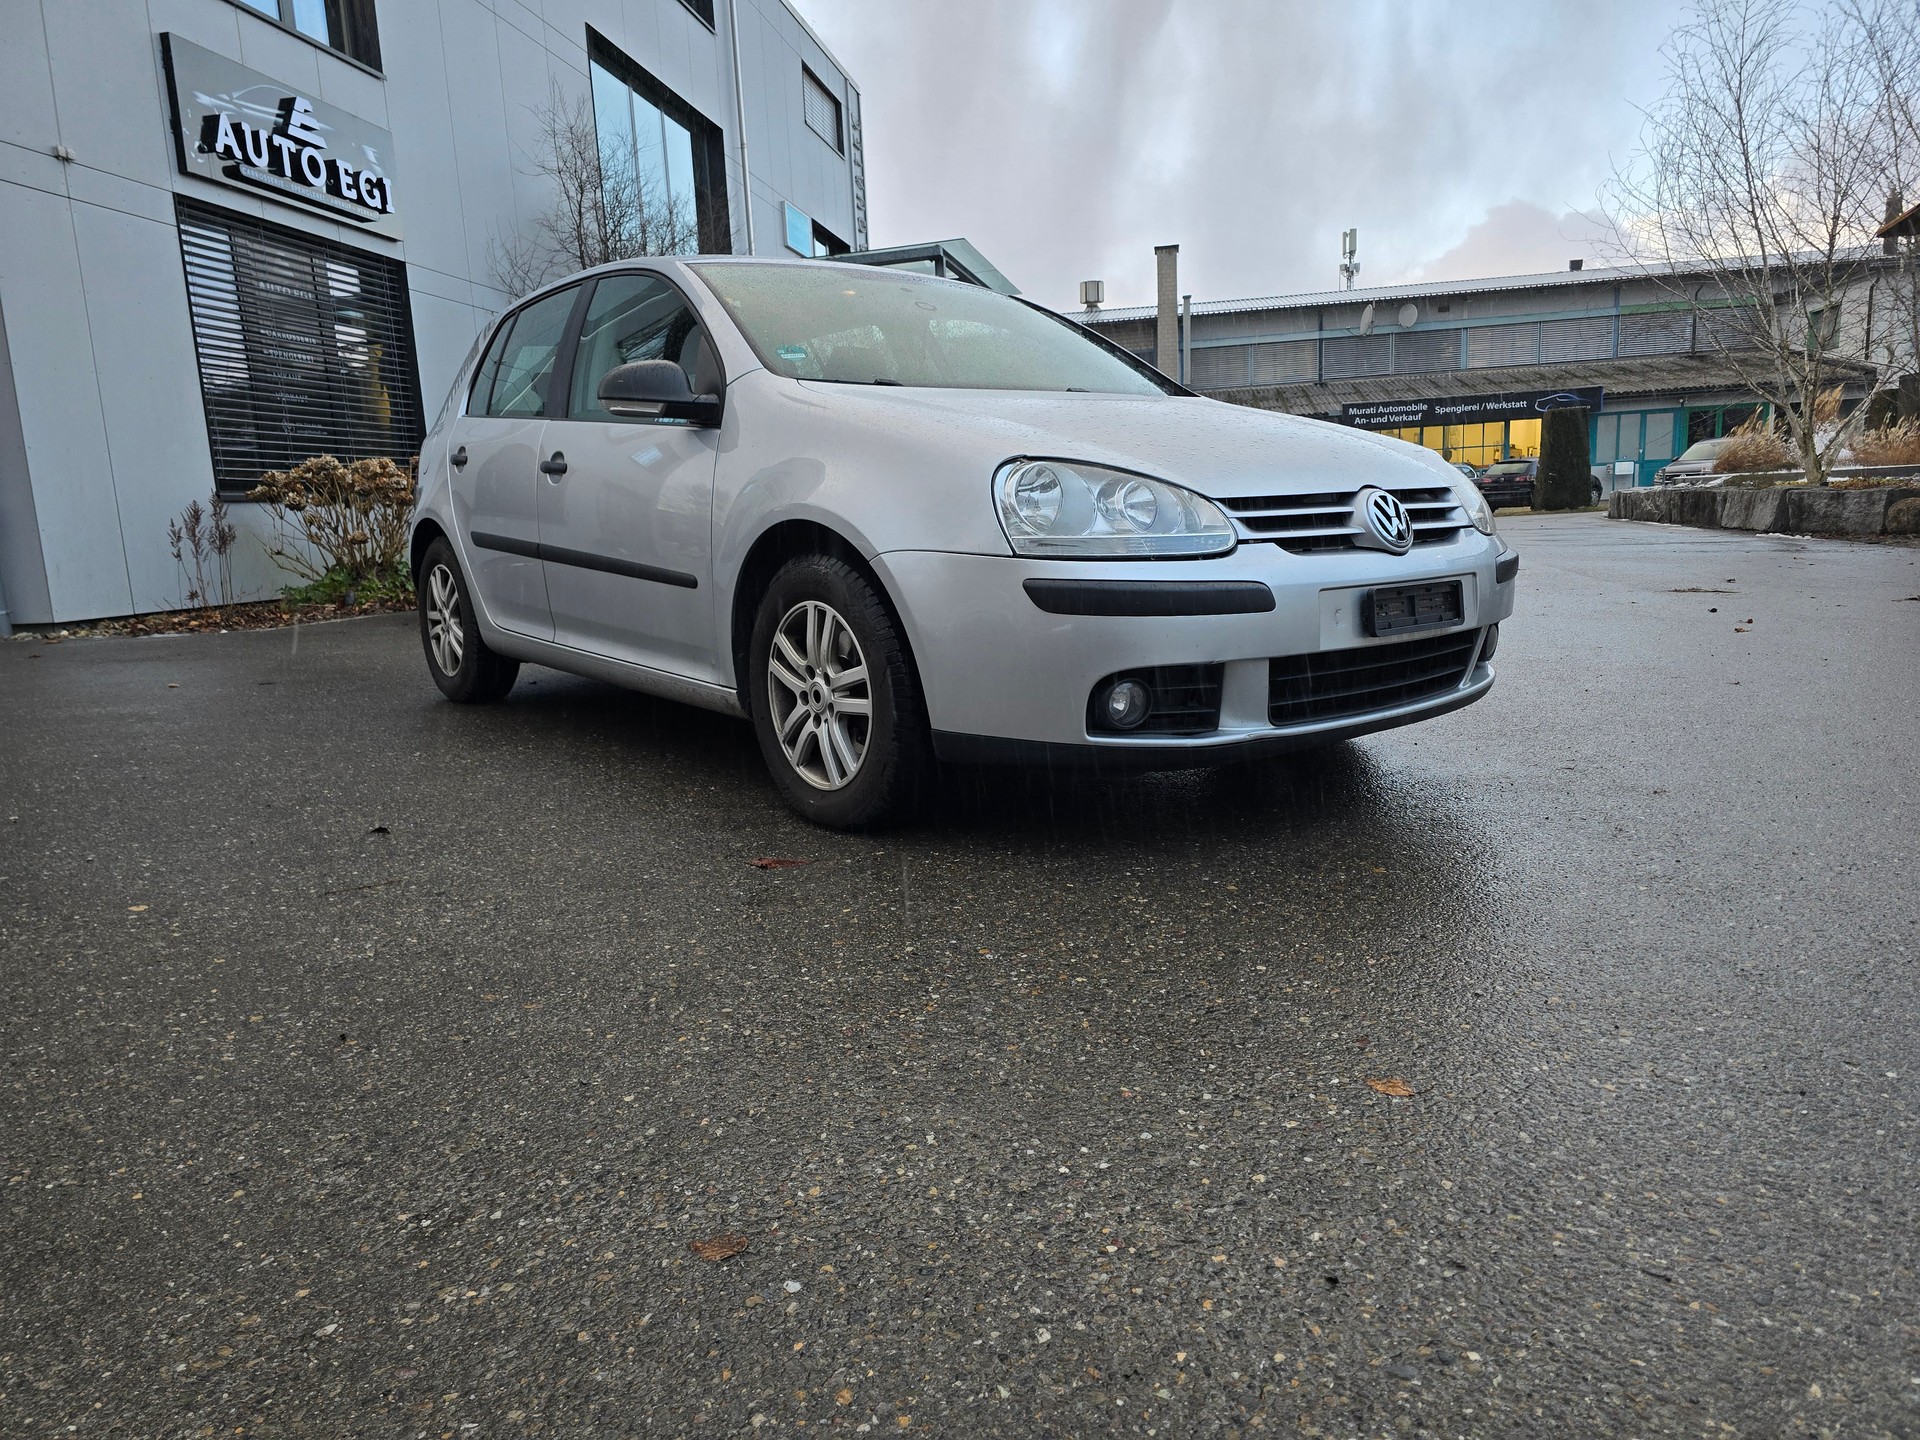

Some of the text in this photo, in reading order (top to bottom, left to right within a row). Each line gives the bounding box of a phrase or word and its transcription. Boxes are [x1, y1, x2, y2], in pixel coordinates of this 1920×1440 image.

[214, 111, 395, 214] AUTO EGI
[242, 167, 284, 187] CARROSSERIE
[1348, 402, 1428, 416] Murati Automobile
[1434, 404, 1480, 415] Spenglerei
[1486, 400, 1527, 410] Werkstatt
[1354, 412, 1423, 425] An- und Verkauf
